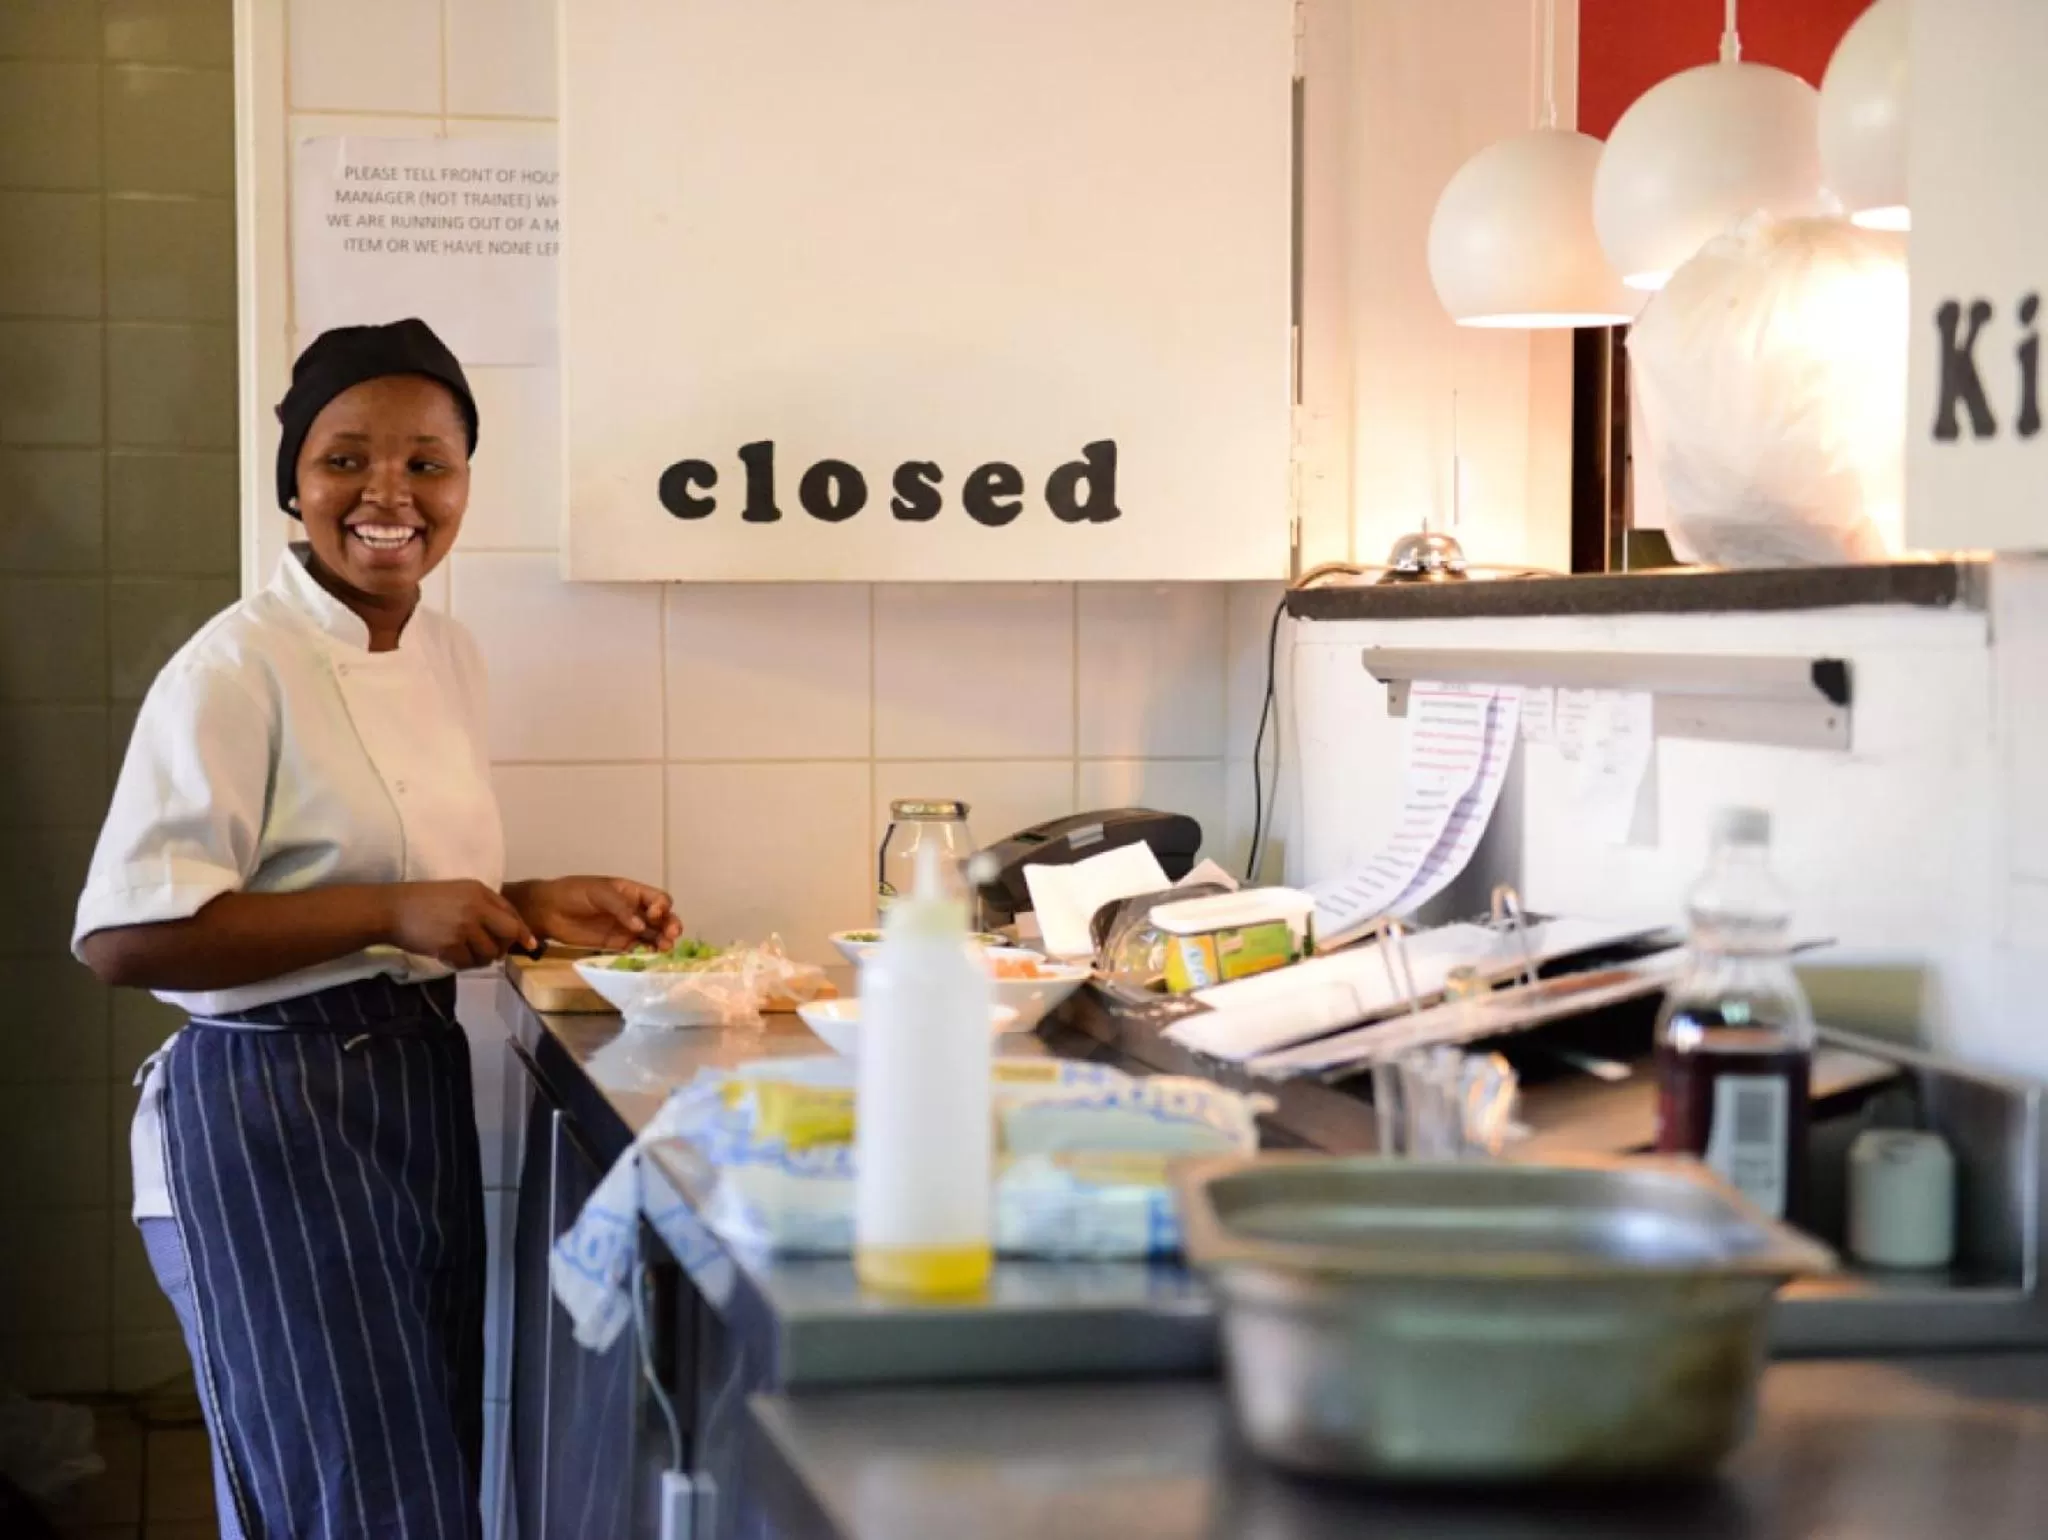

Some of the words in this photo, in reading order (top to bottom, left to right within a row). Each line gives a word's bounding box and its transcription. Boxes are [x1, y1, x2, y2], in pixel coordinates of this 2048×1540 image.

[344, 166, 398, 181] PLEASE
[404, 167, 436, 182] TELL
[441, 167, 493, 183] FRONT
[496, 169, 516, 183] OF
[335, 190, 416, 206] MANAGER
[419, 191, 456, 208] (NOT
[463, 193, 531, 210] TRAINEE)
[326, 213, 353, 228] WE
[356, 214, 385, 229] ARE
[390, 215, 464, 230] RUNNING
[468, 216, 501, 231] OUT
[505, 217, 525, 232] OF
[530, 217, 541, 231] A
[343, 237, 383, 252] ITEM
[386, 238, 410, 253] OR
[414, 239, 439, 254] WE
[443, 240, 483, 254] HAVE
[488, 240, 532, 256] NONE
[1932, 294, 2041, 442] Ki
[659, 439, 1122, 526] closed
